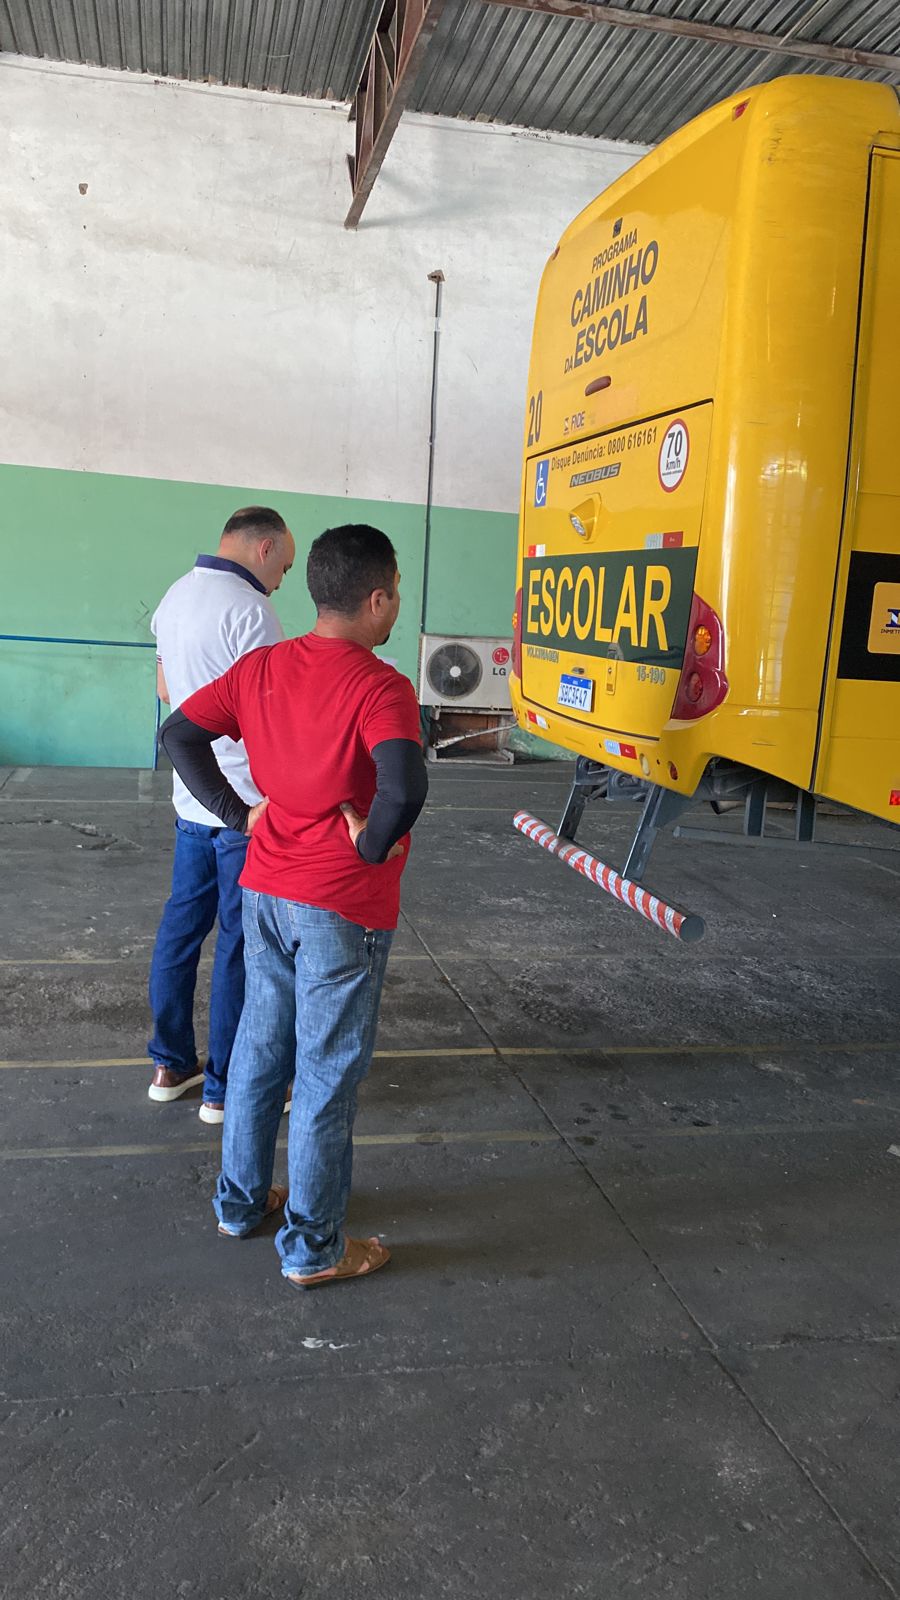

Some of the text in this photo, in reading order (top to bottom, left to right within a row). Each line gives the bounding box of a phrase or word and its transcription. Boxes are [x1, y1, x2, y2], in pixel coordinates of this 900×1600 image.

[592, 228, 637, 273] PROGRAMA
[571, 240, 659, 327] CAMINHO
[564, 295, 648, 374] DA ESCOLA
[528, 390, 542, 447] 20
[551, 427, 657, 471] Disque Denúncia: 0800 616161
[666, 458, 681, 471] km/h
[667, 430, 683, 458] 70
[570, 463, 621, 487] NEOBUS
[527, 565, 672, 651] ESCOLAR
[492, 668, 506, 676] LG
